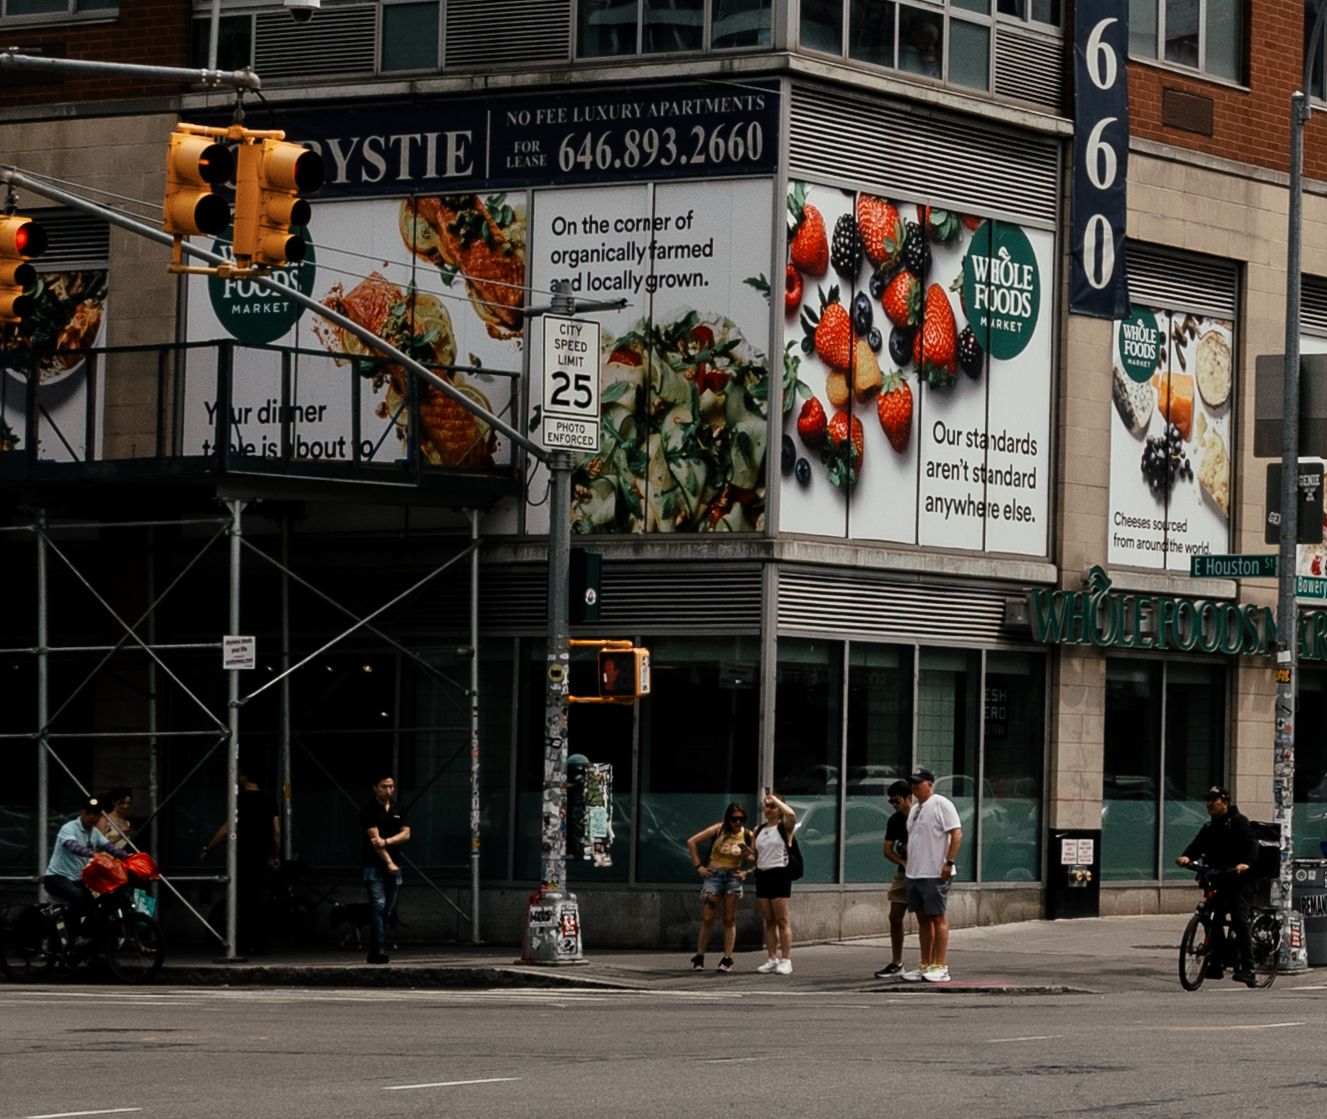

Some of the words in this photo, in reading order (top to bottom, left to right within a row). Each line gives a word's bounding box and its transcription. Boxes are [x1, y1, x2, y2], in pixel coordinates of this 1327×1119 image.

[505, 111, 531, 127] NO
[536, 108, 567, 125] FEE
[573, 102, 646, 123] LUXURY
[648, 95, 766, 118] APARTMENTS
[513, 140, 541, 154] FOR
[558, 121, 764, 173] 646.893.2660
[222, 130, 474, 189] YSTIE
[506, 154, 548, 169] LEASE
[551, 216, 578, 236] On
[582, 215, 610, 234] the
[614, 213, 671, 233] corner
[675, 210, 694, 230] of
[550, 241, 653, 268] organically
[649, 238, 714, 261] farmed
[587, 269, 645, 292] locally
[645, 272, 709, 295] grown.
[971, 254, 1034, 291] WHOLE
[231, 301, 291, 315] MARKET
[974, 283, 1031, 318] FOODS
[559, 324, 583, 337] CITY
[980, 317, 1022, 333] MARKET
[1122, 324, 1157, 344] WHOLE
[554, 338, 588, 353] SPEED
[1124, 340, 1156, 360] FOODS
[558, 354, 584, 368] LIMIT
[550, 371, 593, 409] 25
[204, 401, 252, 425] Yur
[547, 432, 594, 446] ENFORCED
[556, 421, 586, 435] PHOTO
[932, 420, 962, 446] Our
[966, 428, 1038, 456] standards
[202, 436, 256, 458] tle
[261, 435, 277, 459] is
[289, 434, 346, 459] bout
[926, 458, 969, 482] aren't
[972, 463, 1037, 490] standard
[925, 493, 1000, 521] anywhere
[1003, 498, 1036, 523] else.
[1113, 511, 1151, 530] Cheeses
[1152, 519, 1188, 534] sourced
[1113, 532, 1135, 548] from
[1136, 535, 1168, 552] around
[1168, 539, 1183, 553] the
[1185, 542, 1212, 556] world.
[1194, 563, 1201, 576] E
[1206, 558, 1260, 576] Houston
[1264, 558, 1274, 569] St
[1298, 576, 1327, 598] Bowery
[1027, 588, 1153, 648] WHOLE
[1155, 596, 1263, 657] FOODS
